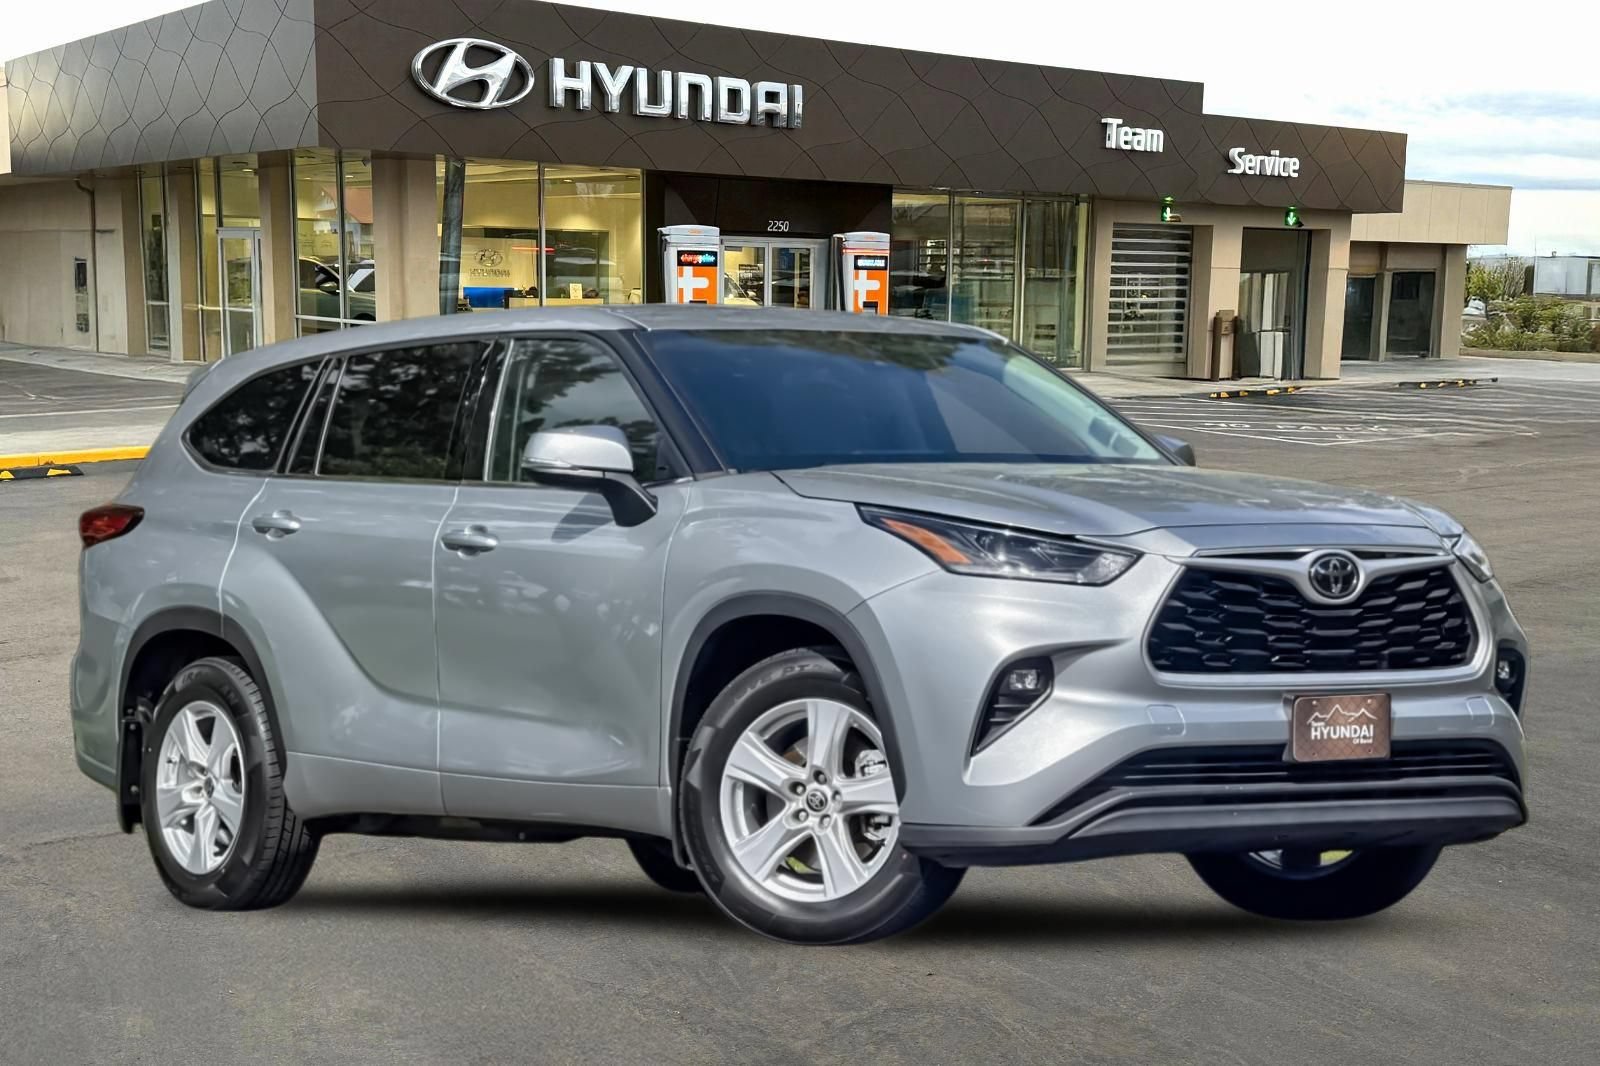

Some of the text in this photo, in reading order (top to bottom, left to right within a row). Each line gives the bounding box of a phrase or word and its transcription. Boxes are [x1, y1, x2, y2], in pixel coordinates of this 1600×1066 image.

[549, 57, 803, 129] HYUNDAI
[1101, 117, 1164, 152] Team
[1227, 147, 1300, 178] Service
[767, 220, 790, 232] 2250
[1311, 724, 1374, 740] HYUNDAI
